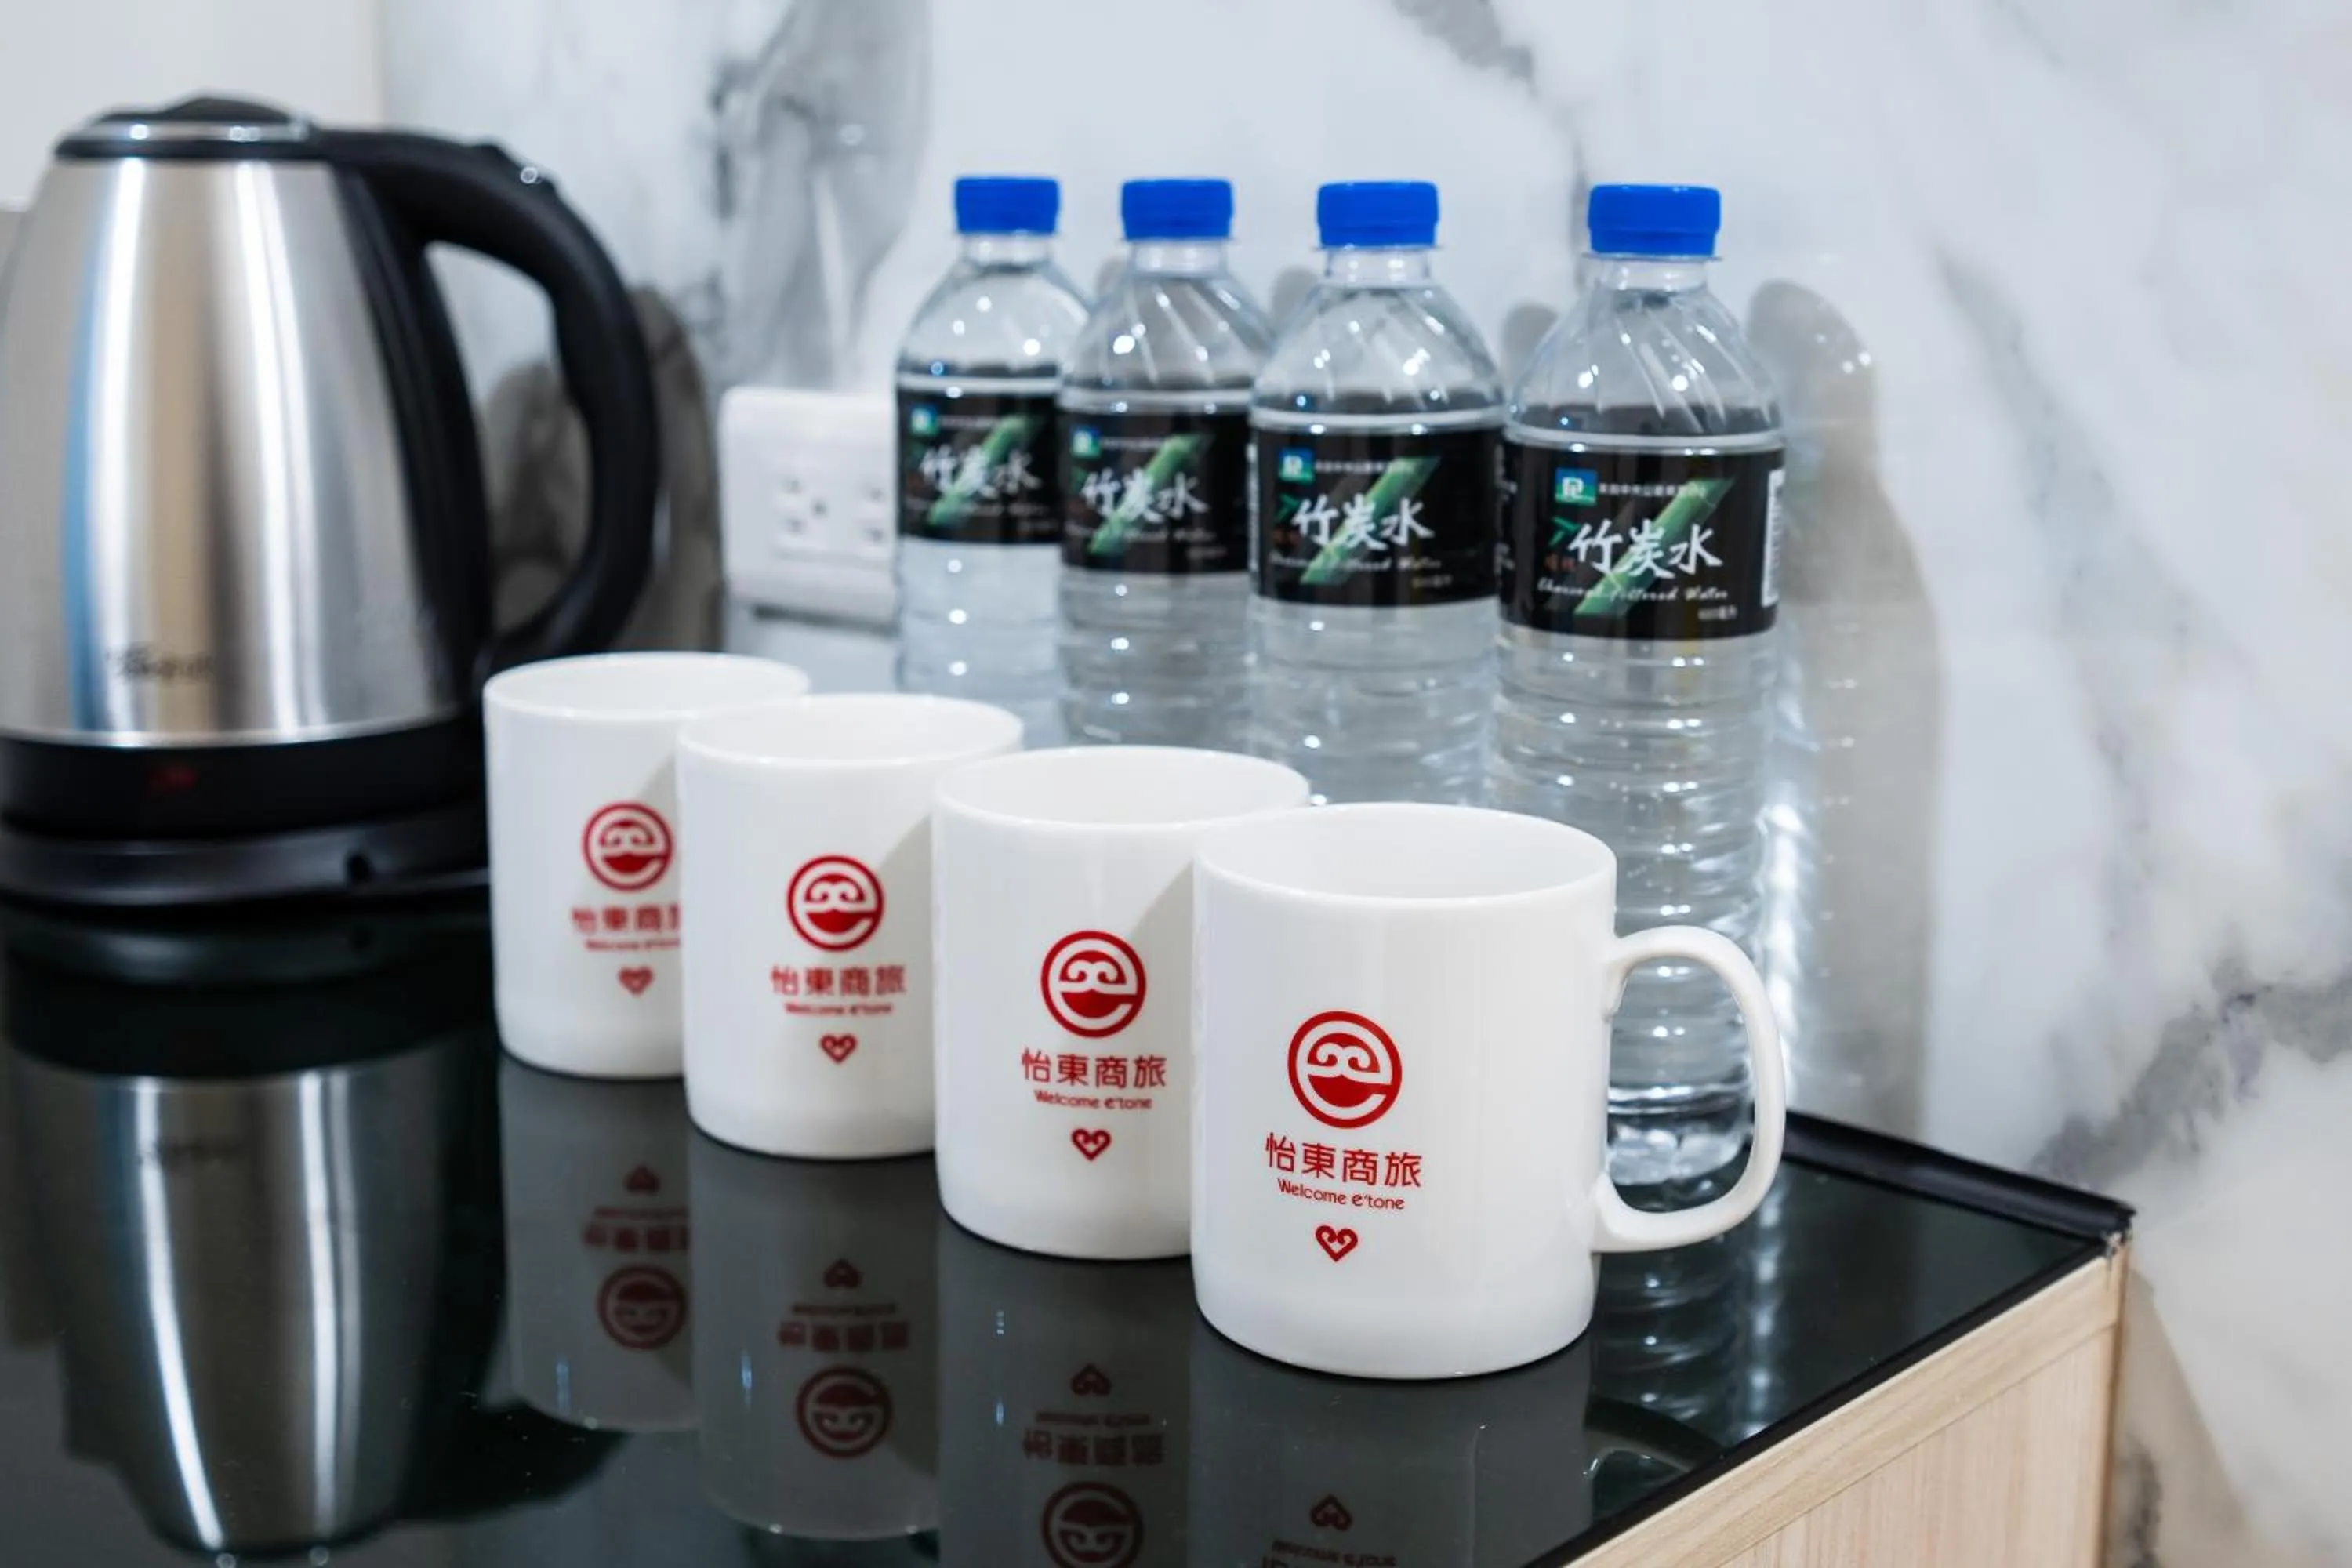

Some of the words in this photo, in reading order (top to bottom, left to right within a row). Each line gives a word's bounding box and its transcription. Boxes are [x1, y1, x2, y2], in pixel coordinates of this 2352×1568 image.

[1081, 468, 1210, 523] 竹炭水
[1292, 493, 1436, 550] 竹炭水
[1568, 518, 1723, 579] 竹炭水
[1021, 1048, 1167, 1089] 怡東商旅
[1033, 1089, 1099, 1109] Welcome
[1265, 1131, 1423, 1189] 怡東商旅
[1277, 1178, 1346, 1205] Welcome
[1352, 1193, 1405, 1210] e'tone
